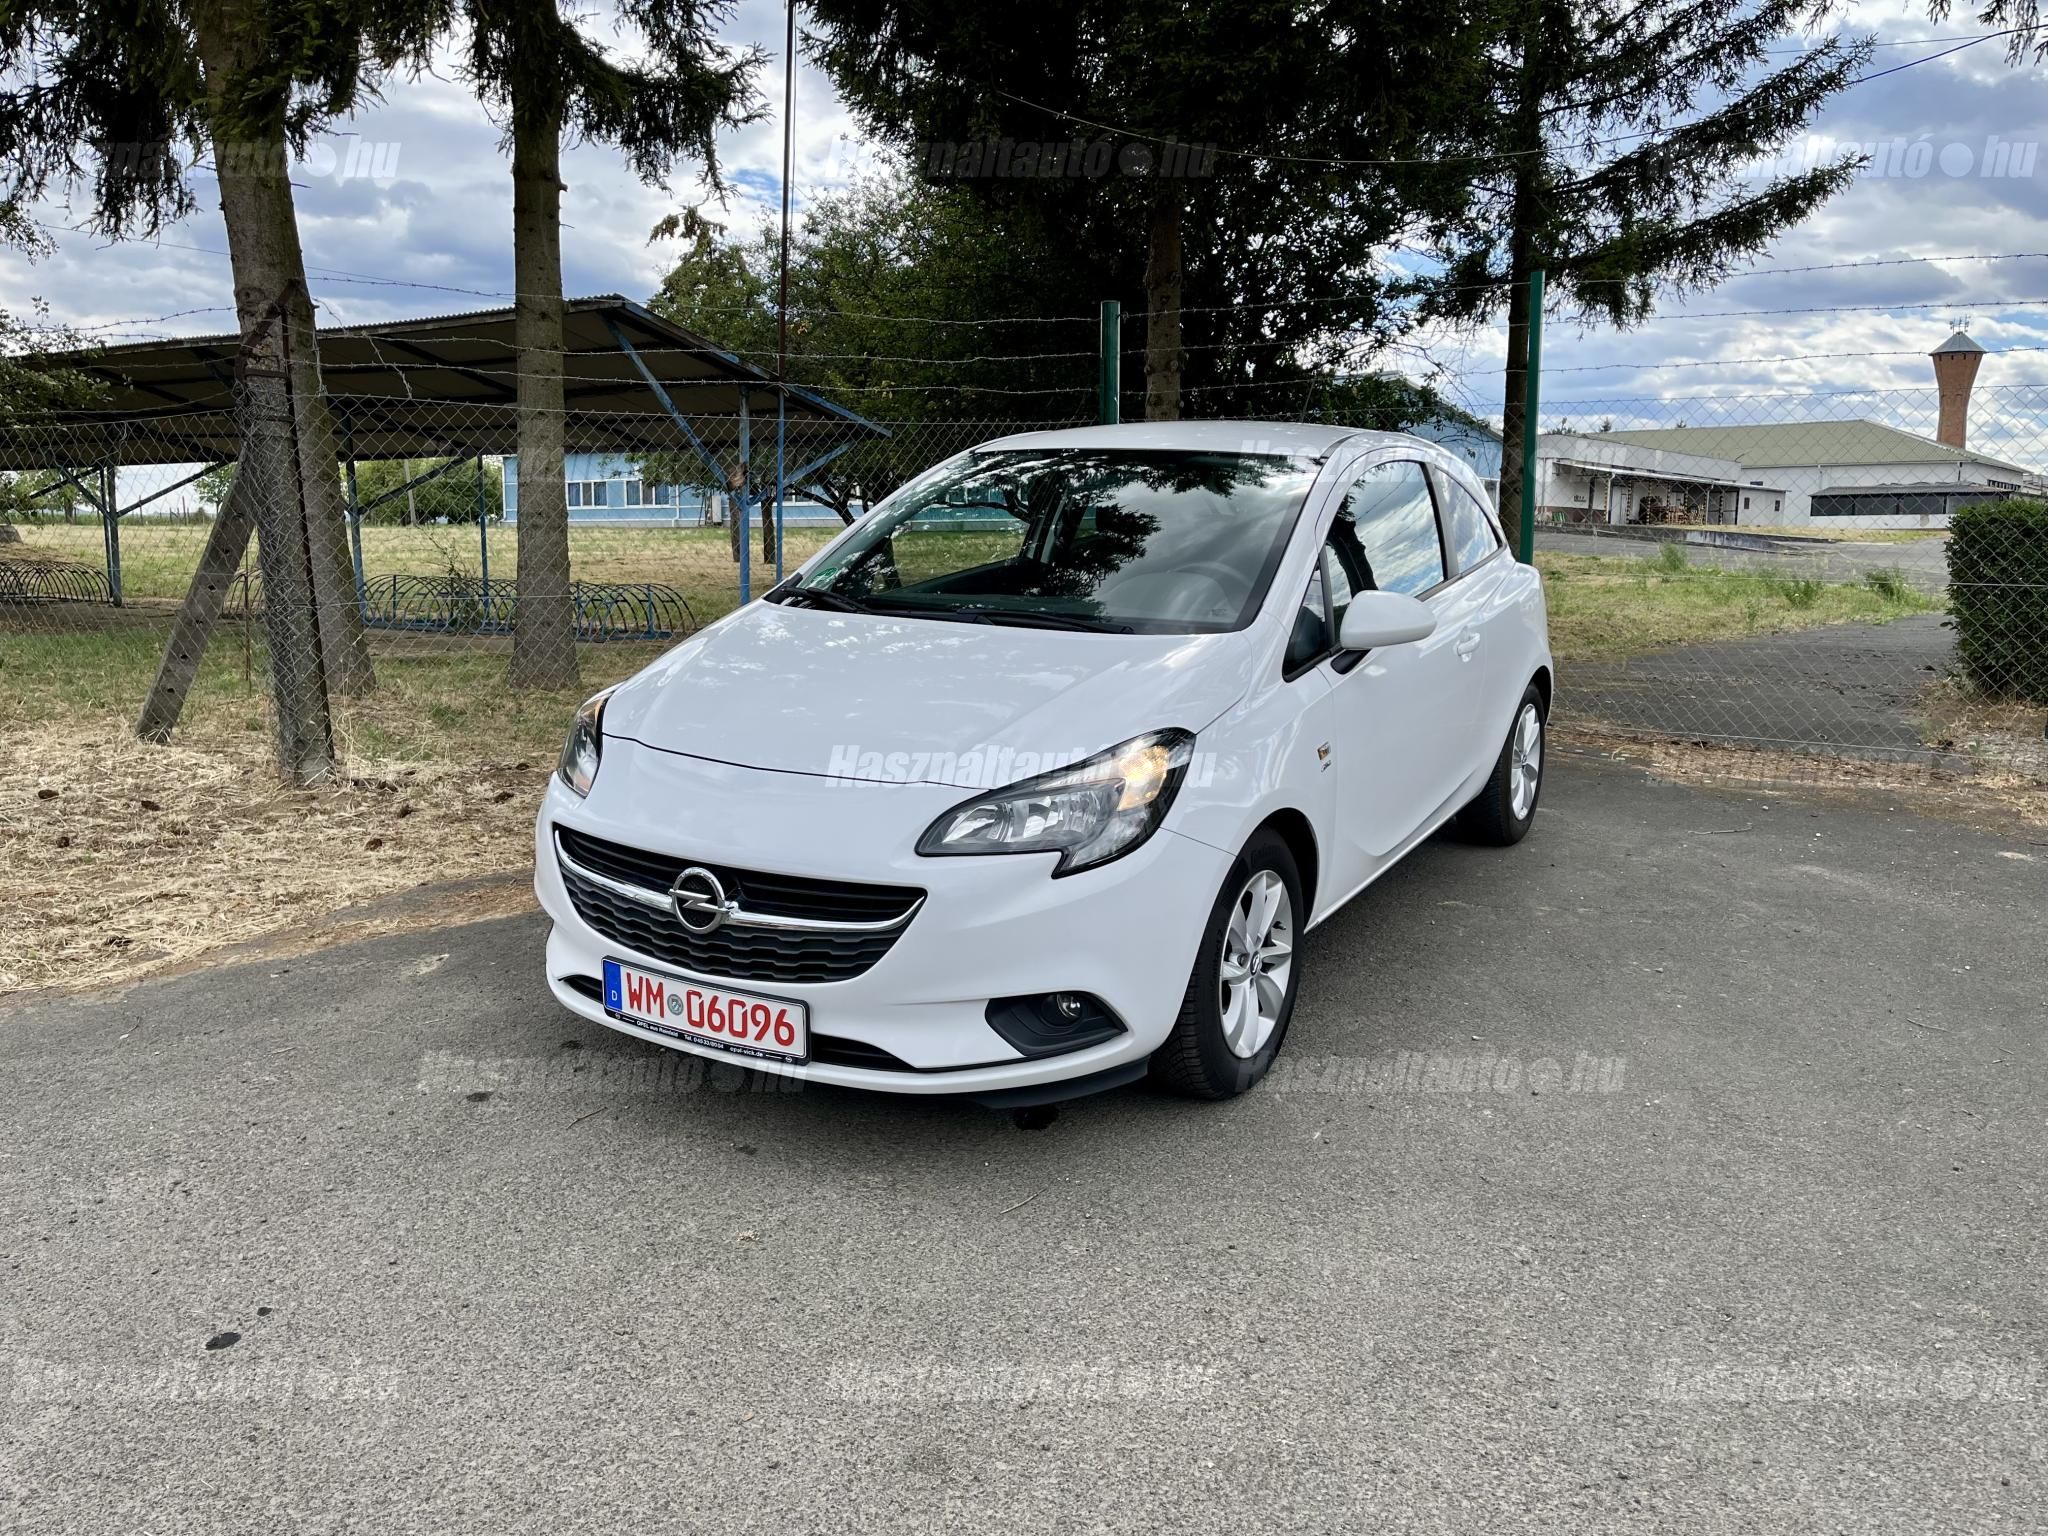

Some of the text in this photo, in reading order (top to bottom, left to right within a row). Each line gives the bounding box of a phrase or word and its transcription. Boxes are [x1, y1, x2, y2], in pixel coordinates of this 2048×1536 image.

[611, 972, 795, 1047] D WM 06096
